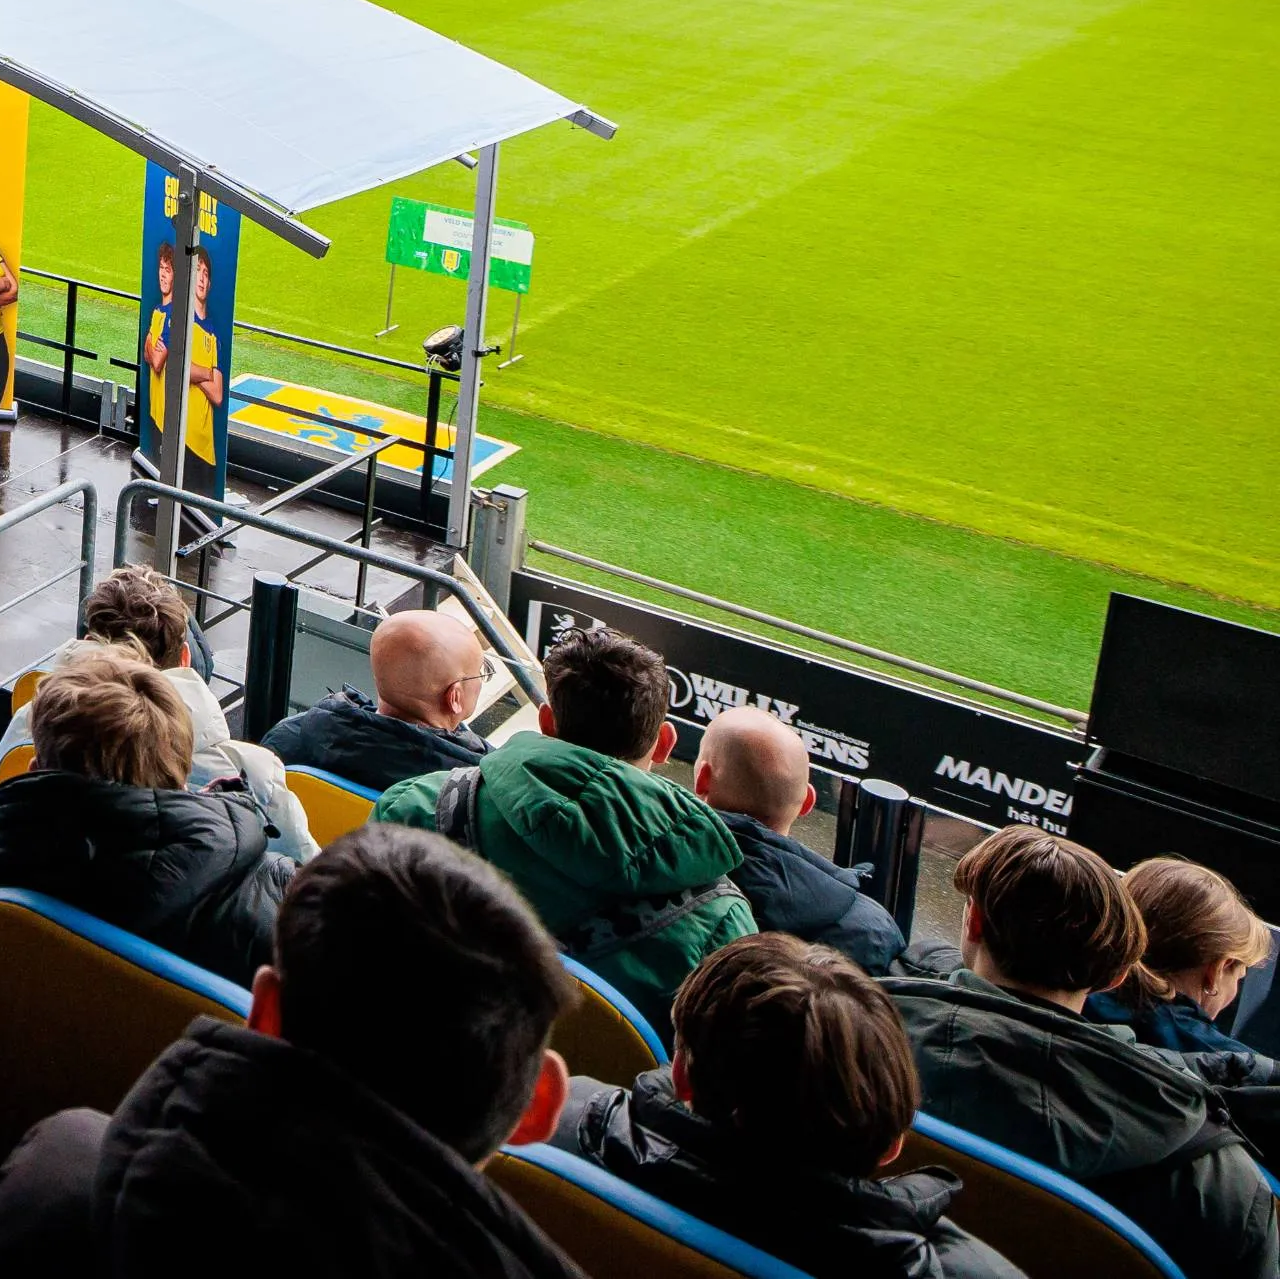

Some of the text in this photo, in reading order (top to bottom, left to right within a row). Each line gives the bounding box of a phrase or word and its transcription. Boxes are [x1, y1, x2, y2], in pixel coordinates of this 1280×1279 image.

[690, 672, 800, 726] WILLY
[1007, 804, 1069, 838] hét hu
